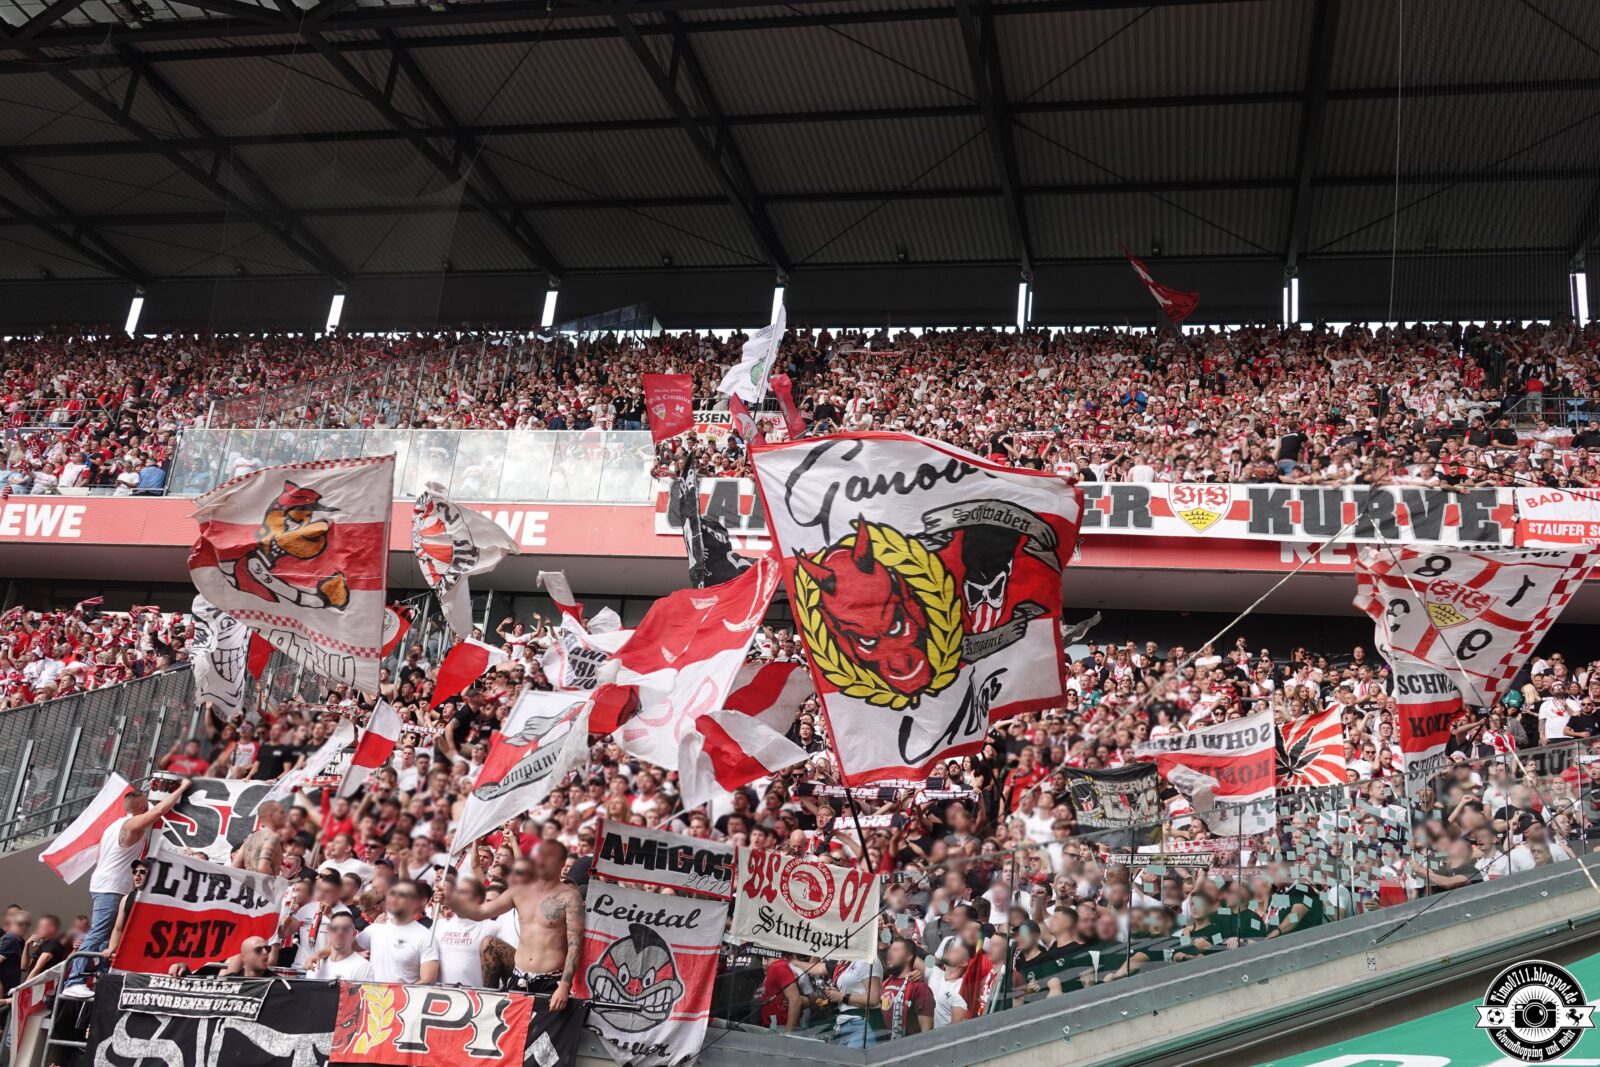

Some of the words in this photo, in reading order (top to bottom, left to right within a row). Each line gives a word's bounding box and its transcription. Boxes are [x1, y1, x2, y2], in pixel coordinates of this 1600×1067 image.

[1248, 486, 1501, 541] KURVE
[1526, 492, 1564, 508] BAD
[0, 503, 87, 538] EWE
[952, 505, 1031, 533] Schwaben
[1528, 522, 1585, 537] STAUFER
[148, 857, 275, 911] LTRAS
[682, 872, 732, 895] 2010
[839, 869, 876, 923] 07
[587, 893, 702, 929] Leintal
[751, 905, 851, 953] Stuttgart
[143, 919, 237, 959] SEIT
[120, 991, 212, 1011] VERSTORBENEN
[212, 998, 260, 1015] ULTRAS
[394, 985, 512, 1060] PI
